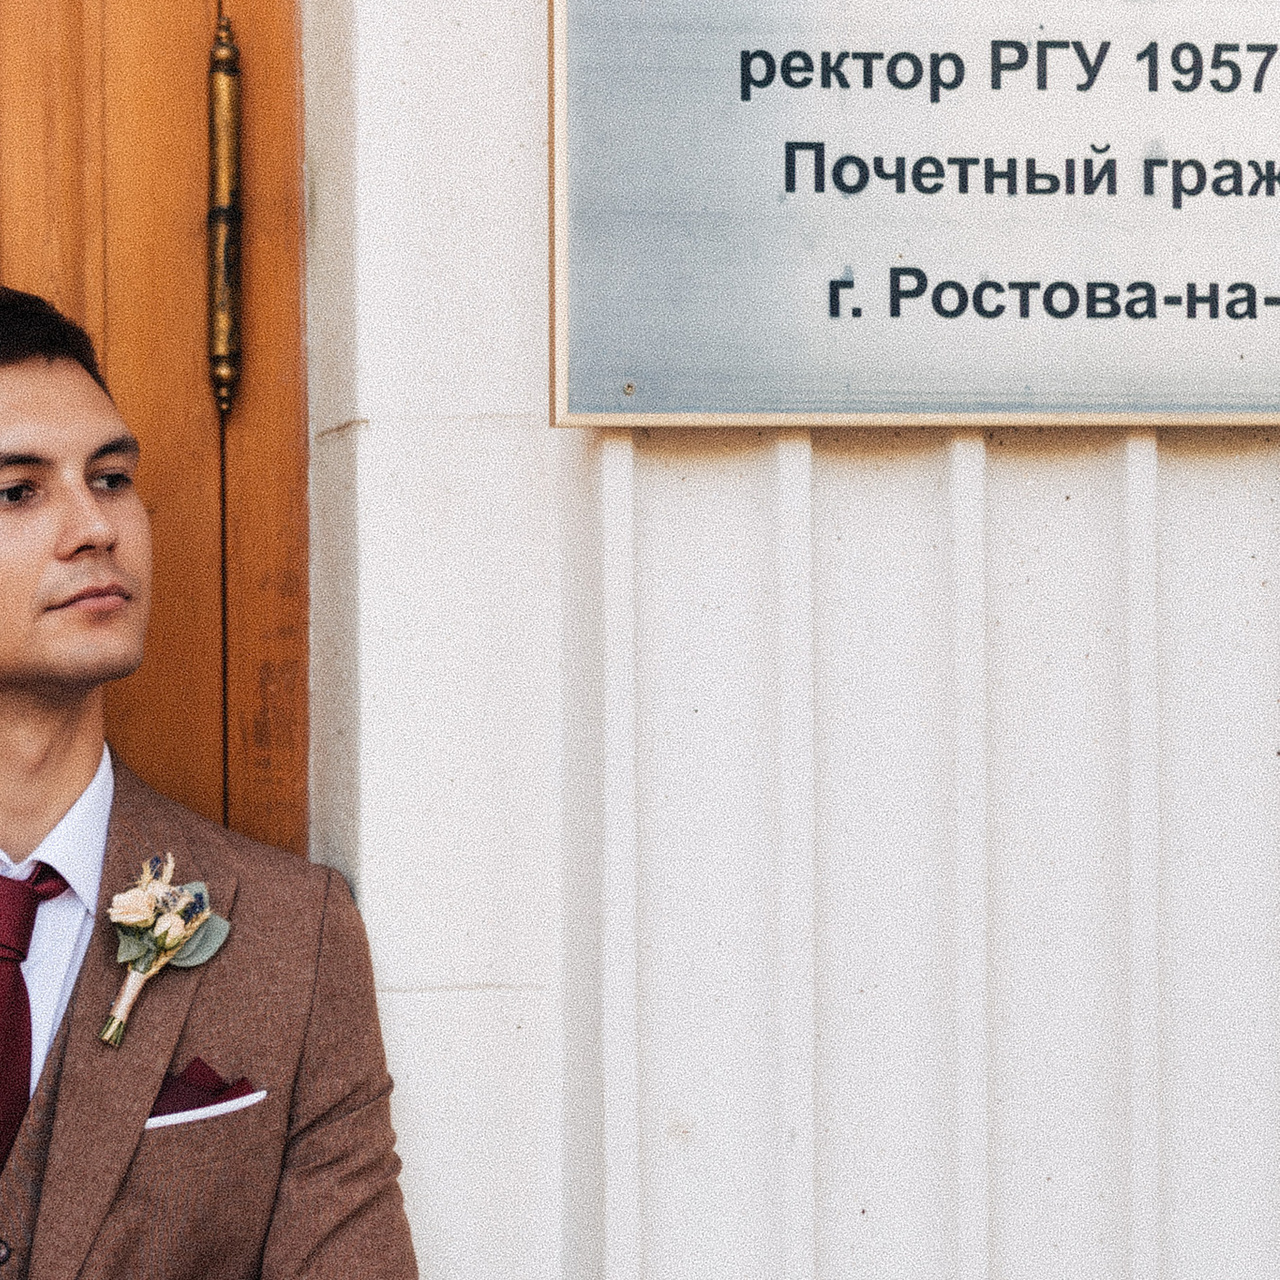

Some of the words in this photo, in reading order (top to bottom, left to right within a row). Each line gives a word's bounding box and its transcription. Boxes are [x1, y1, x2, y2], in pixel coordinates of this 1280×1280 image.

[738, 47, 966, 105] ректор
[989, 38, 1112, 93] РГУ
[1135, 40, 1279, 94] 1957
[783, 140, 1118, 197] Почетный
[827, 276, 864, 320] г.
[888, 265, 1280, 321] Ростова-на-
